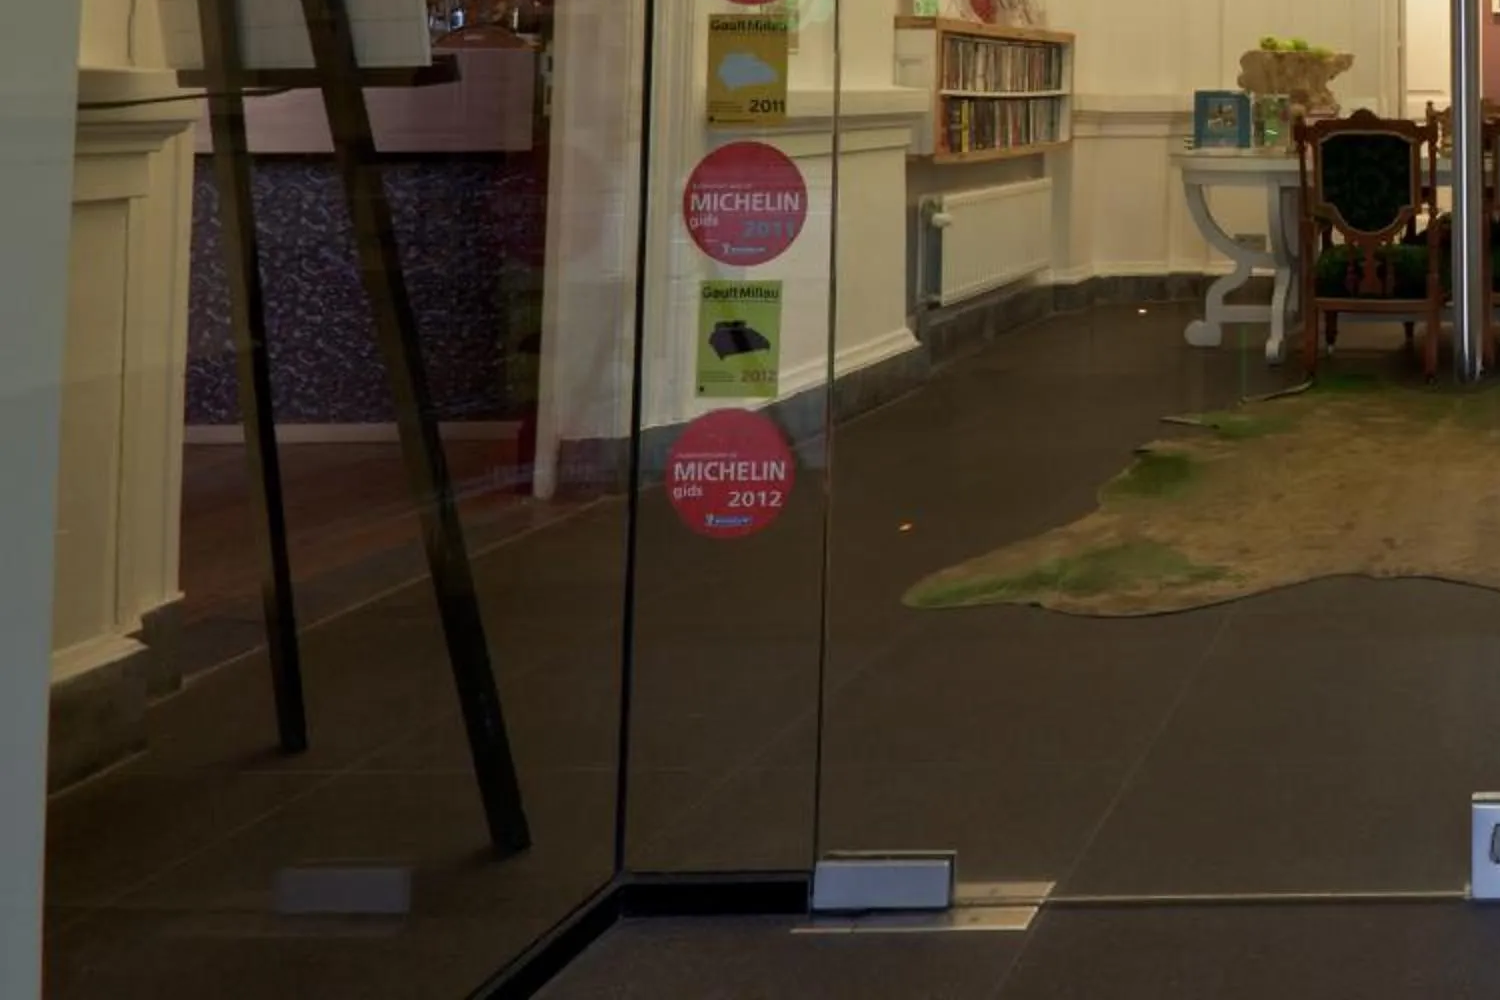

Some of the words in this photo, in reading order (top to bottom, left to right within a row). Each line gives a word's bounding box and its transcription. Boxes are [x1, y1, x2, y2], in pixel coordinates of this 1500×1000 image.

[749, 99, 786, 113] 2011
[690, 191, 801, 212] MICHELIN
[741, 219, 796, 240] 2011
[741, 370, 778, 383] 2012
[673, 461, 786, 482] MICHELIN
[672, 485, 704, 500] gids
[727, 490, 783, 508] 2012
